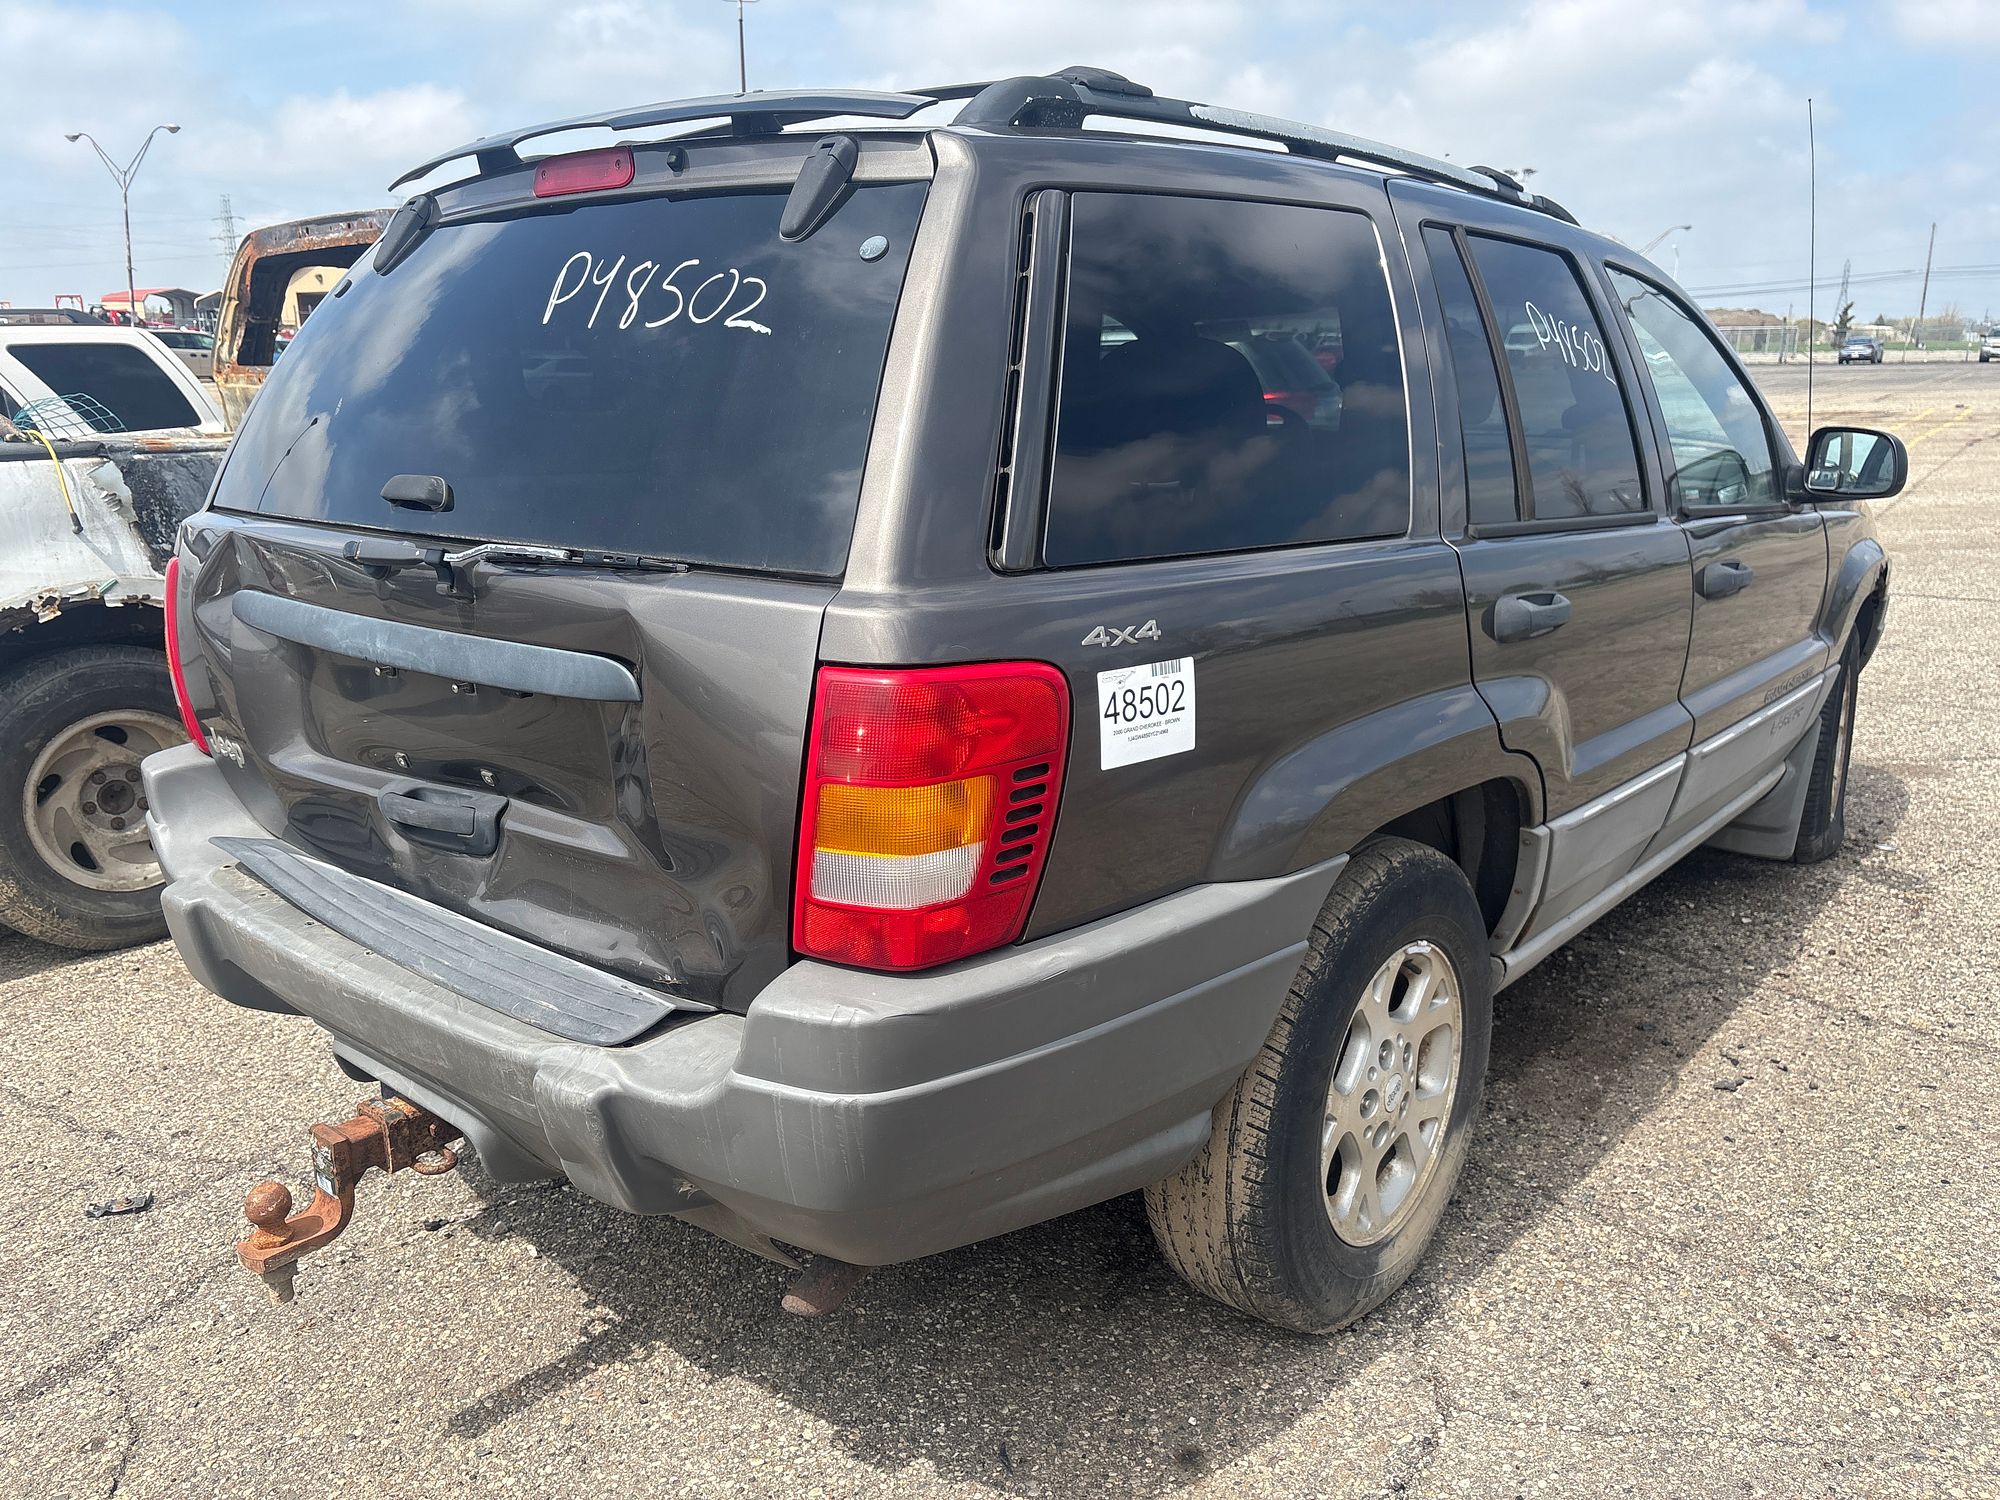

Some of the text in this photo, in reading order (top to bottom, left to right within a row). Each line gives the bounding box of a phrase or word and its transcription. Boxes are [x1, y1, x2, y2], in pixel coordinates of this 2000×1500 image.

[542, 251, 772, 336] P48502
[1104, 680, 1185, 724] 48502
[210, 727, 245, 768] Jeep
